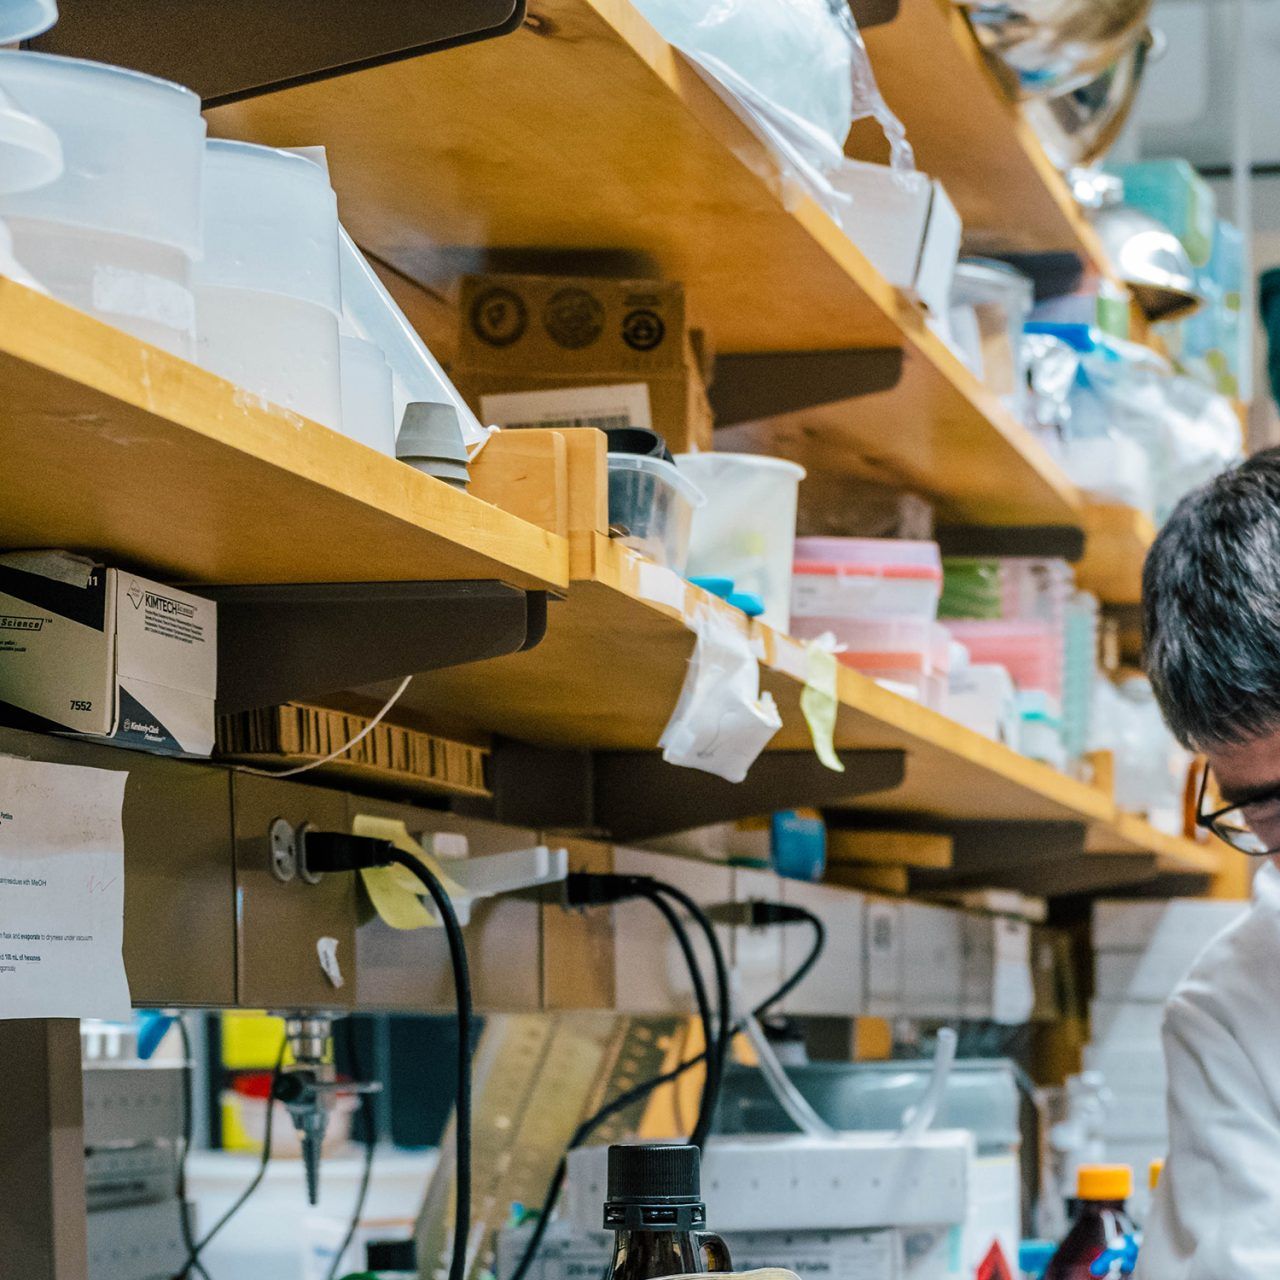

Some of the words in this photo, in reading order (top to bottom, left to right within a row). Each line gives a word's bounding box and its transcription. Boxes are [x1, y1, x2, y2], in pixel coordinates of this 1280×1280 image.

[145, 594, 177, 615] KIMTECH
[1, 619, 40, 629] Science
[70, 700, 92, 711] 7552
